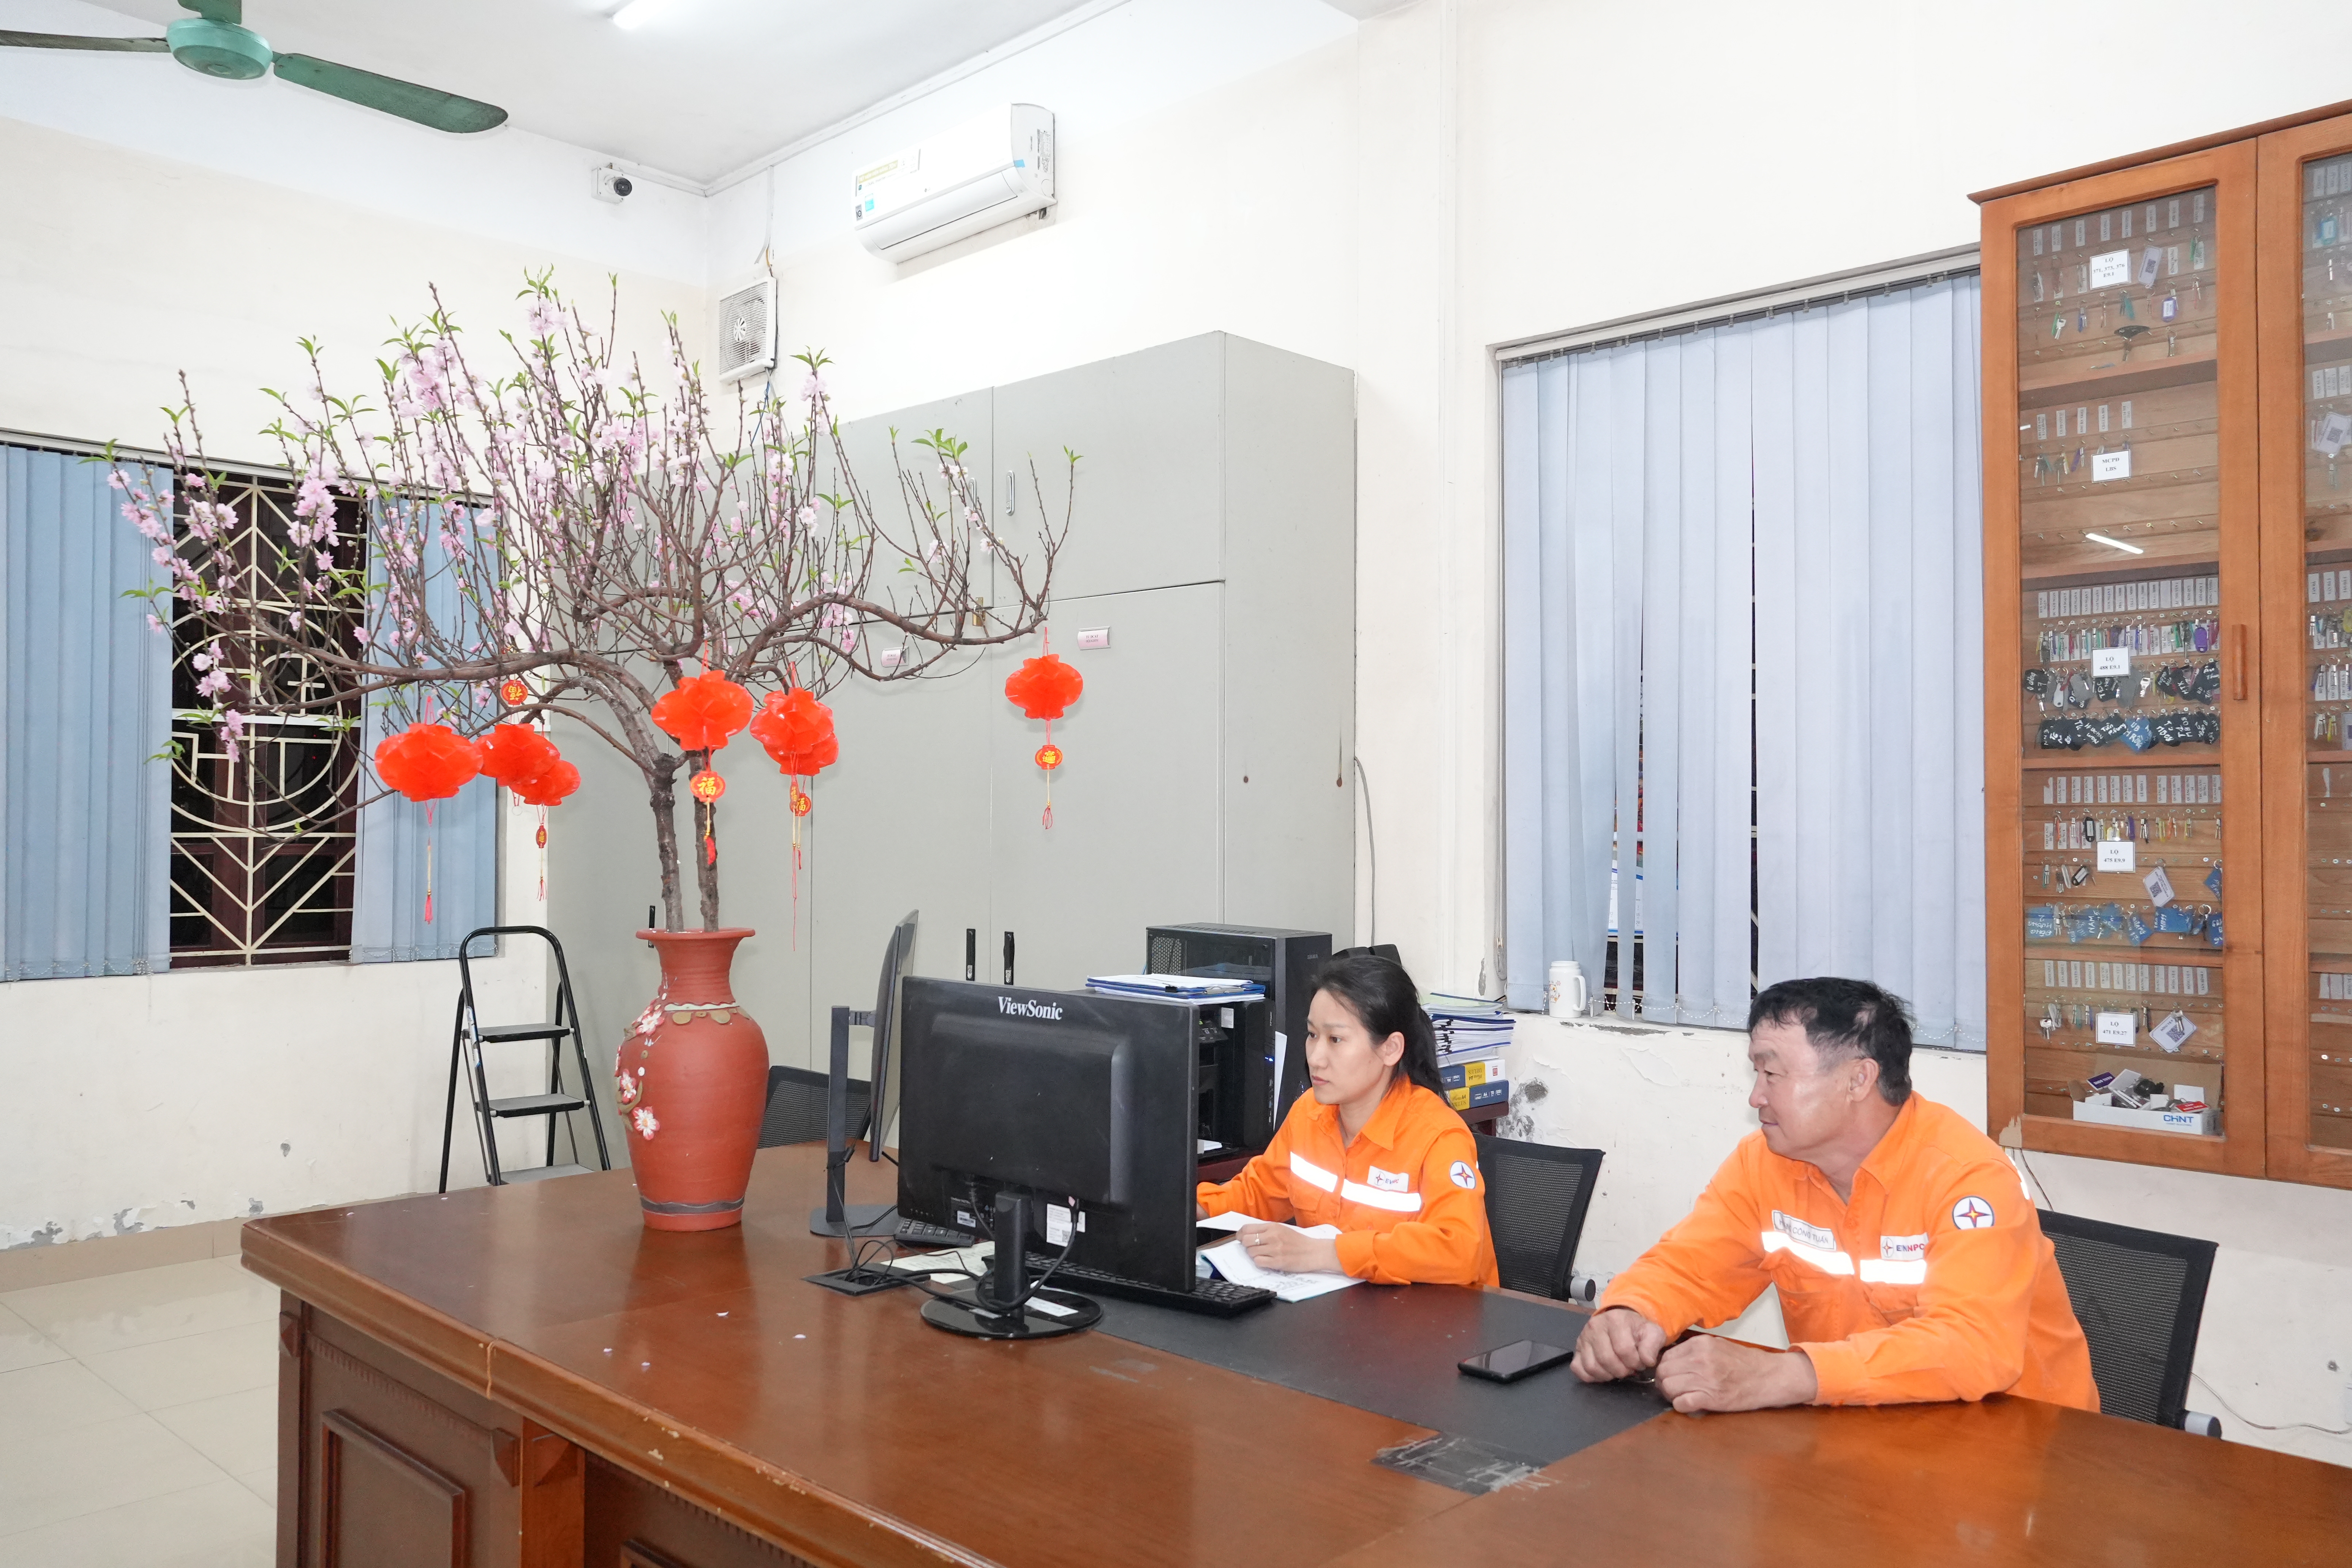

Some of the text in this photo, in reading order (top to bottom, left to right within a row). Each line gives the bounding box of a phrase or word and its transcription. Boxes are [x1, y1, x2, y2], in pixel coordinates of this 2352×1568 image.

[698, 776, 718, 796] 福
[998, 996, 1063, 1020] ViewSonic
[2163, 1115, 2194, 1123] CHINT
[1792, 1227, 1811, 1238] CÔNG
